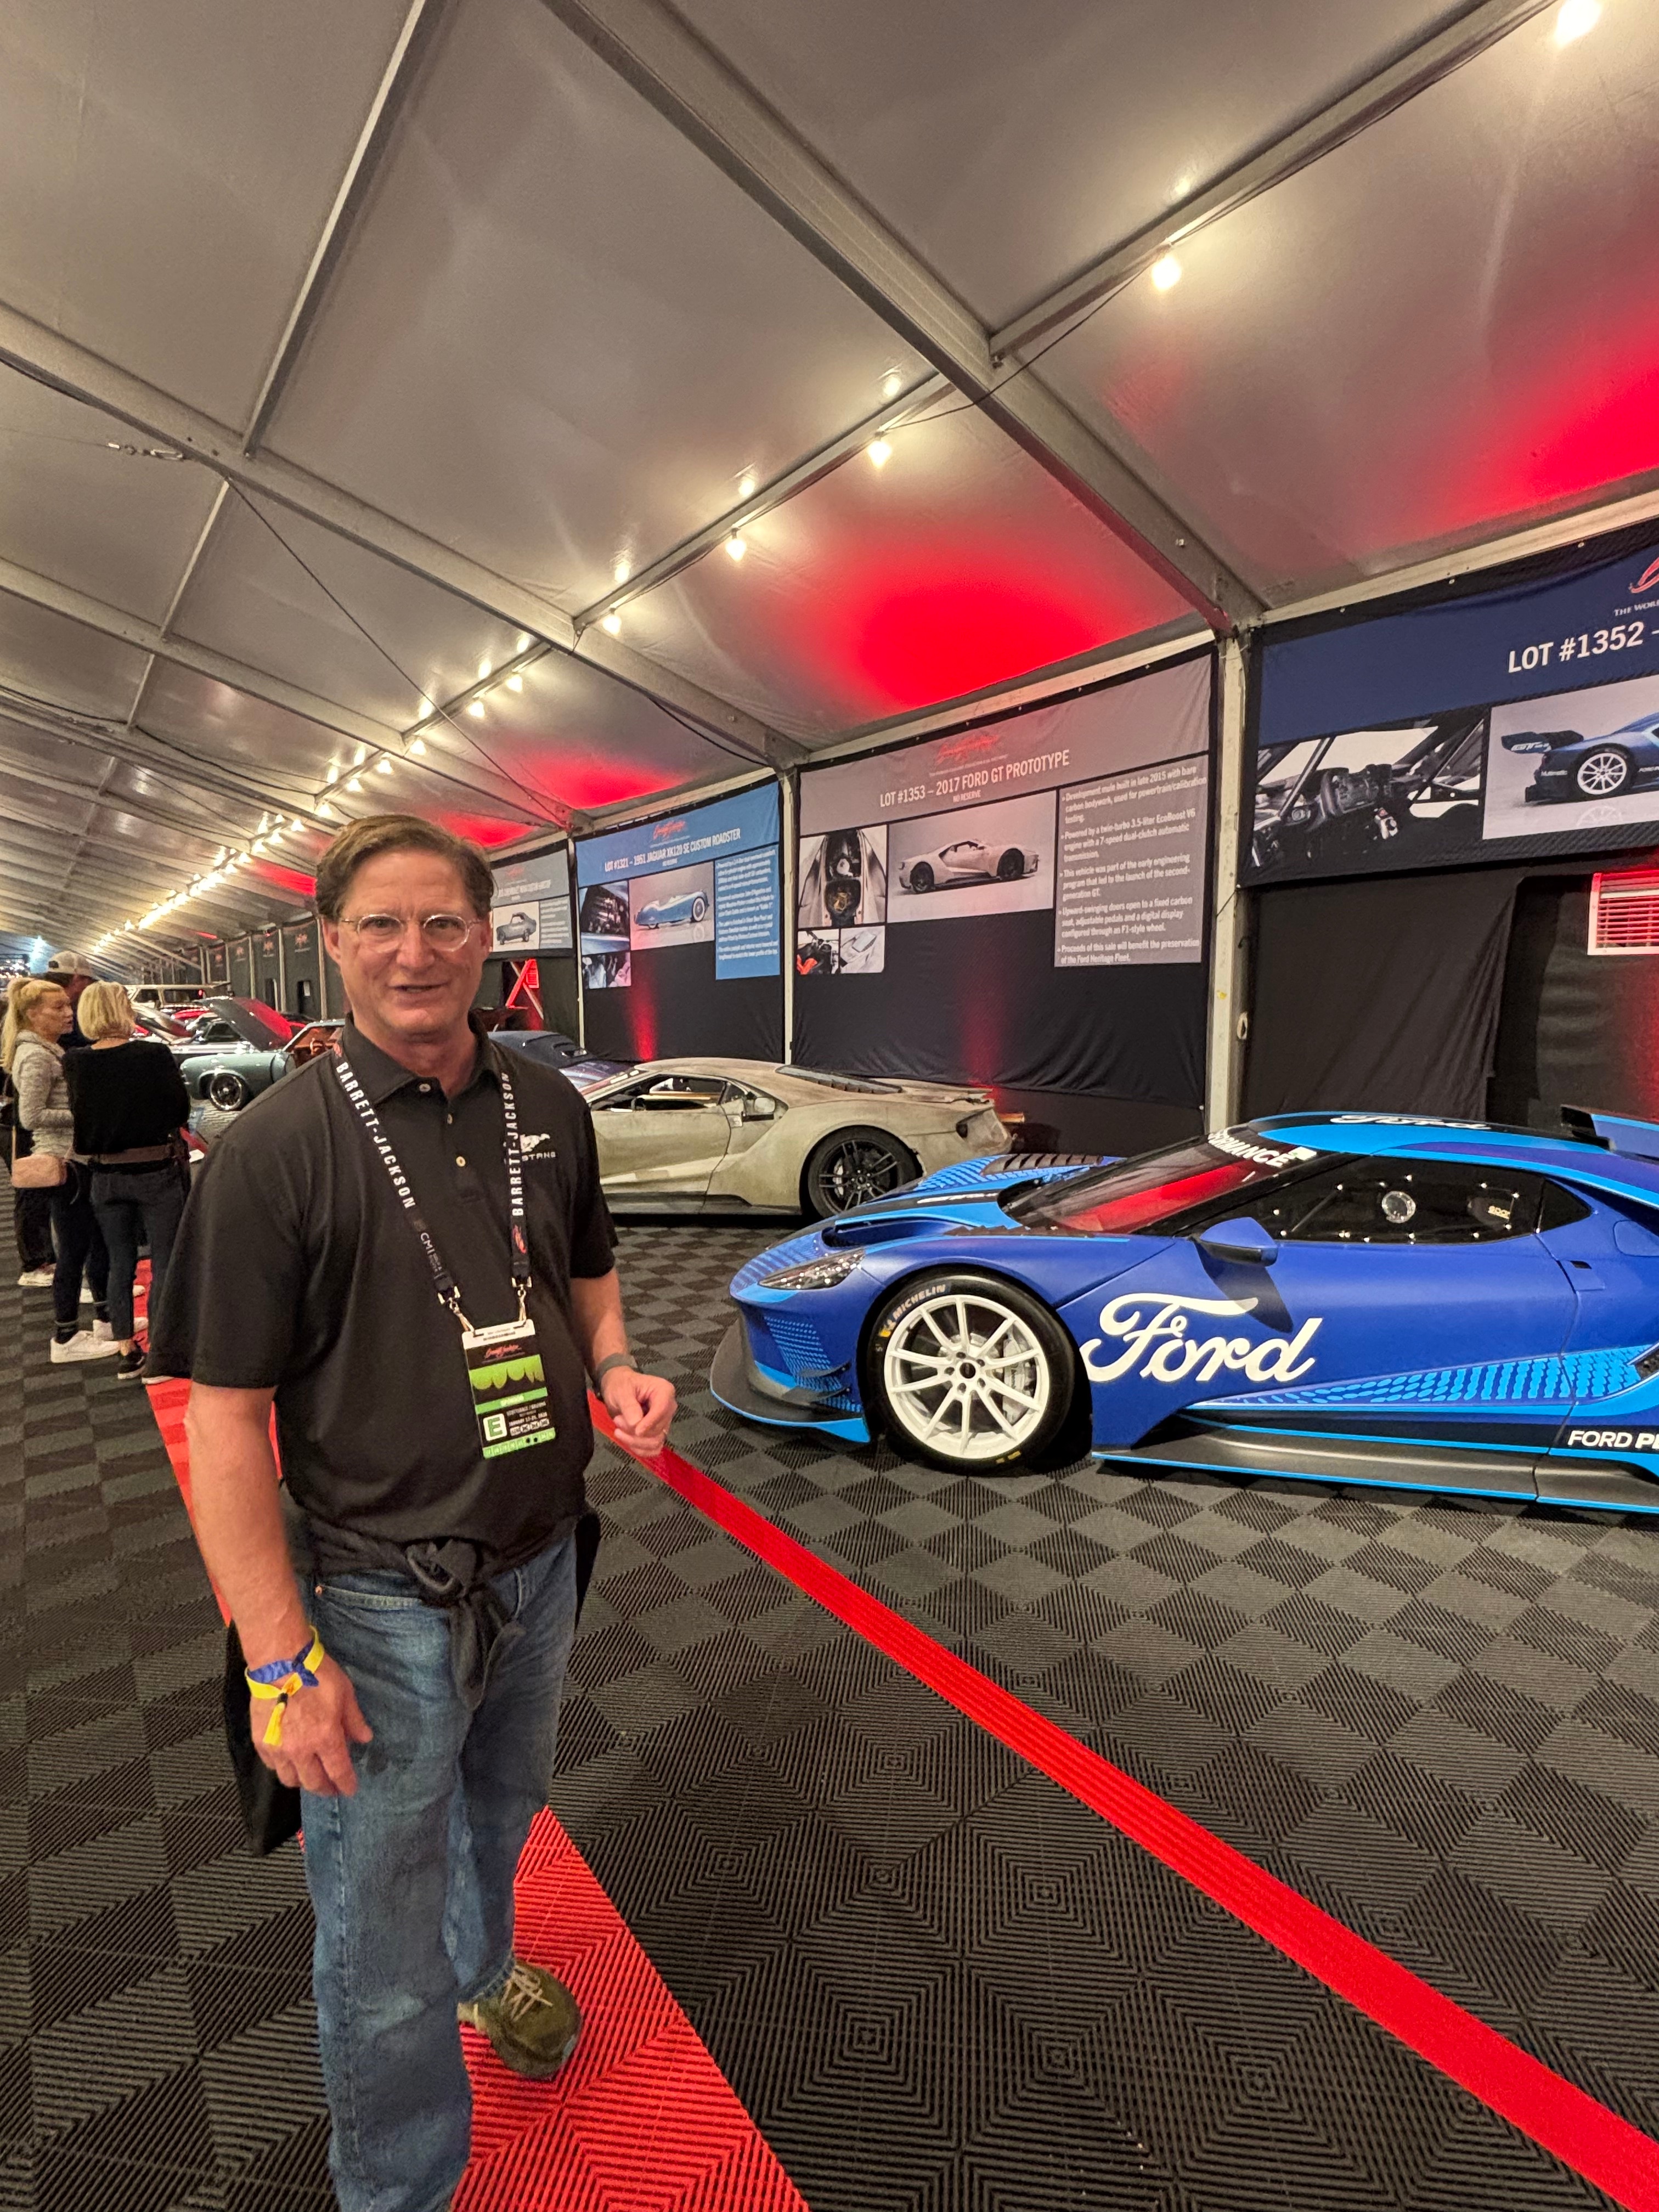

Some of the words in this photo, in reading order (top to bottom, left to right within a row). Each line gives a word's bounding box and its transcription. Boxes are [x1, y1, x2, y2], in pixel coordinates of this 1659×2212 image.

[1508, 641, 1554, 673] LOT
[1559, 621, 1644, 662] #1352
[880, 791, 896, 808] LOT
[898, 785, 925, 804] #1353
[936, 777, 960, 796] 2017
[962, 771, 988, 791] FORD
[991, 766, 1003, 783] GT
[1006, 749, 1070, 780] PROTOTYPE
[1150, 771, 1166, 783] 2015
[713, 827, 741, 847] ROADSTER
[336, 1062, 416, 1209] BARRETT-JACKSON
[501, 1072, 524, 1216] BARRETT-JACKSON
[521, 1151, 556, 1162] STANG
[892, 1284, 946, 1320] MICHELIN
[1079, 1293, 1323, 1382] Ford
[487, 1417, 503, 1437] E
[1567, 1430, 1633, 1447] FORD
